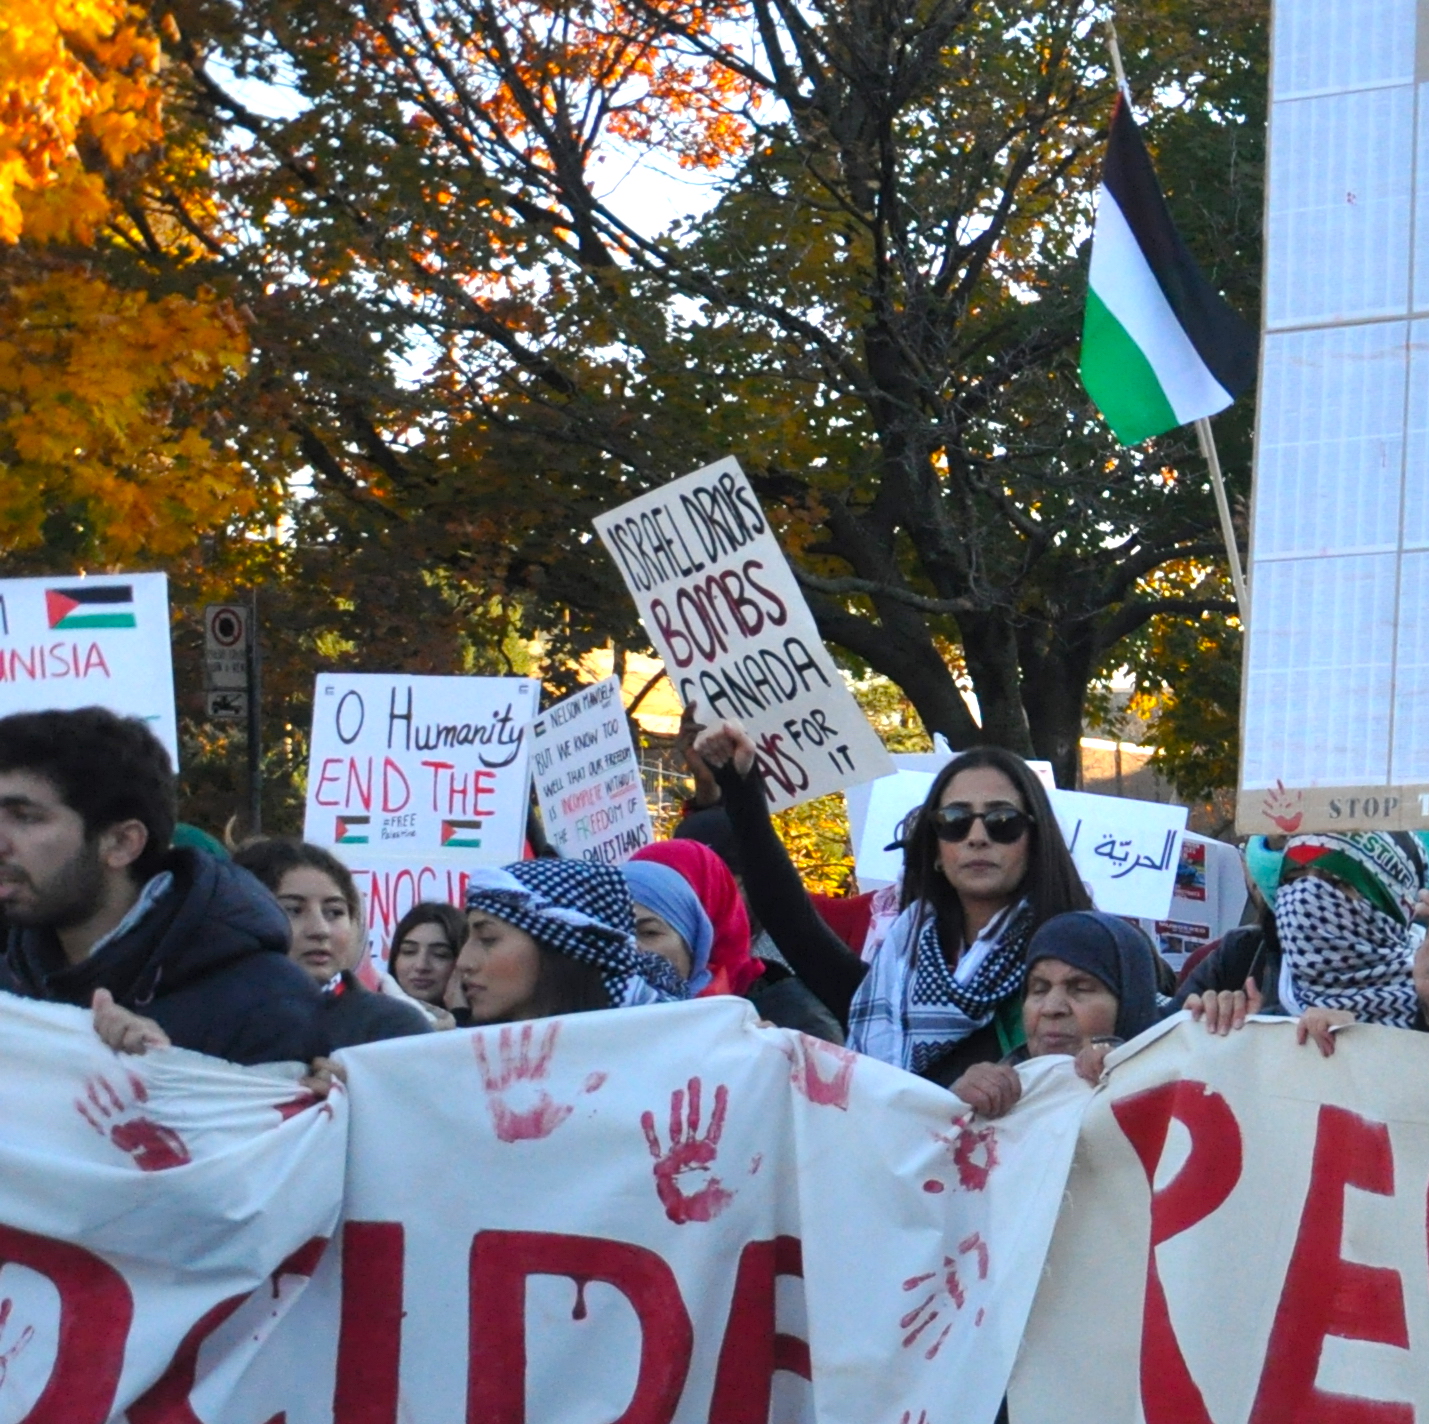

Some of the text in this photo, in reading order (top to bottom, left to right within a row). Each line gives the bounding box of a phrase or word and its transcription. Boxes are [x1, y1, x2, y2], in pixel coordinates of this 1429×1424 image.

[607, 472, 765, 592] ISRAEL DROPS
[650, 559, 787, 668] BOMBS
[680, 636, 831, 719] CANADA
[336, 685, 524, 768] O Humanity
[549, 682, 615, 728] NELSON MANDELA
[556, 740, 572, 760] WE
[573, 729, 598, 752] KNOW
[602, 718, 619, 739] TOO
[754, 708, 839, 803] AYS FOR
[827, 744, 856, 775] IT
[315, 756, 496, 816] END THE
[542, 746, 631, 798] WELL THAT OUR FREEDOM
[548, 804, 557, 822] IS
[553, 797, 638, 847] THE FREEDOM OF
[1329, 796, 1399, 819] STOP
